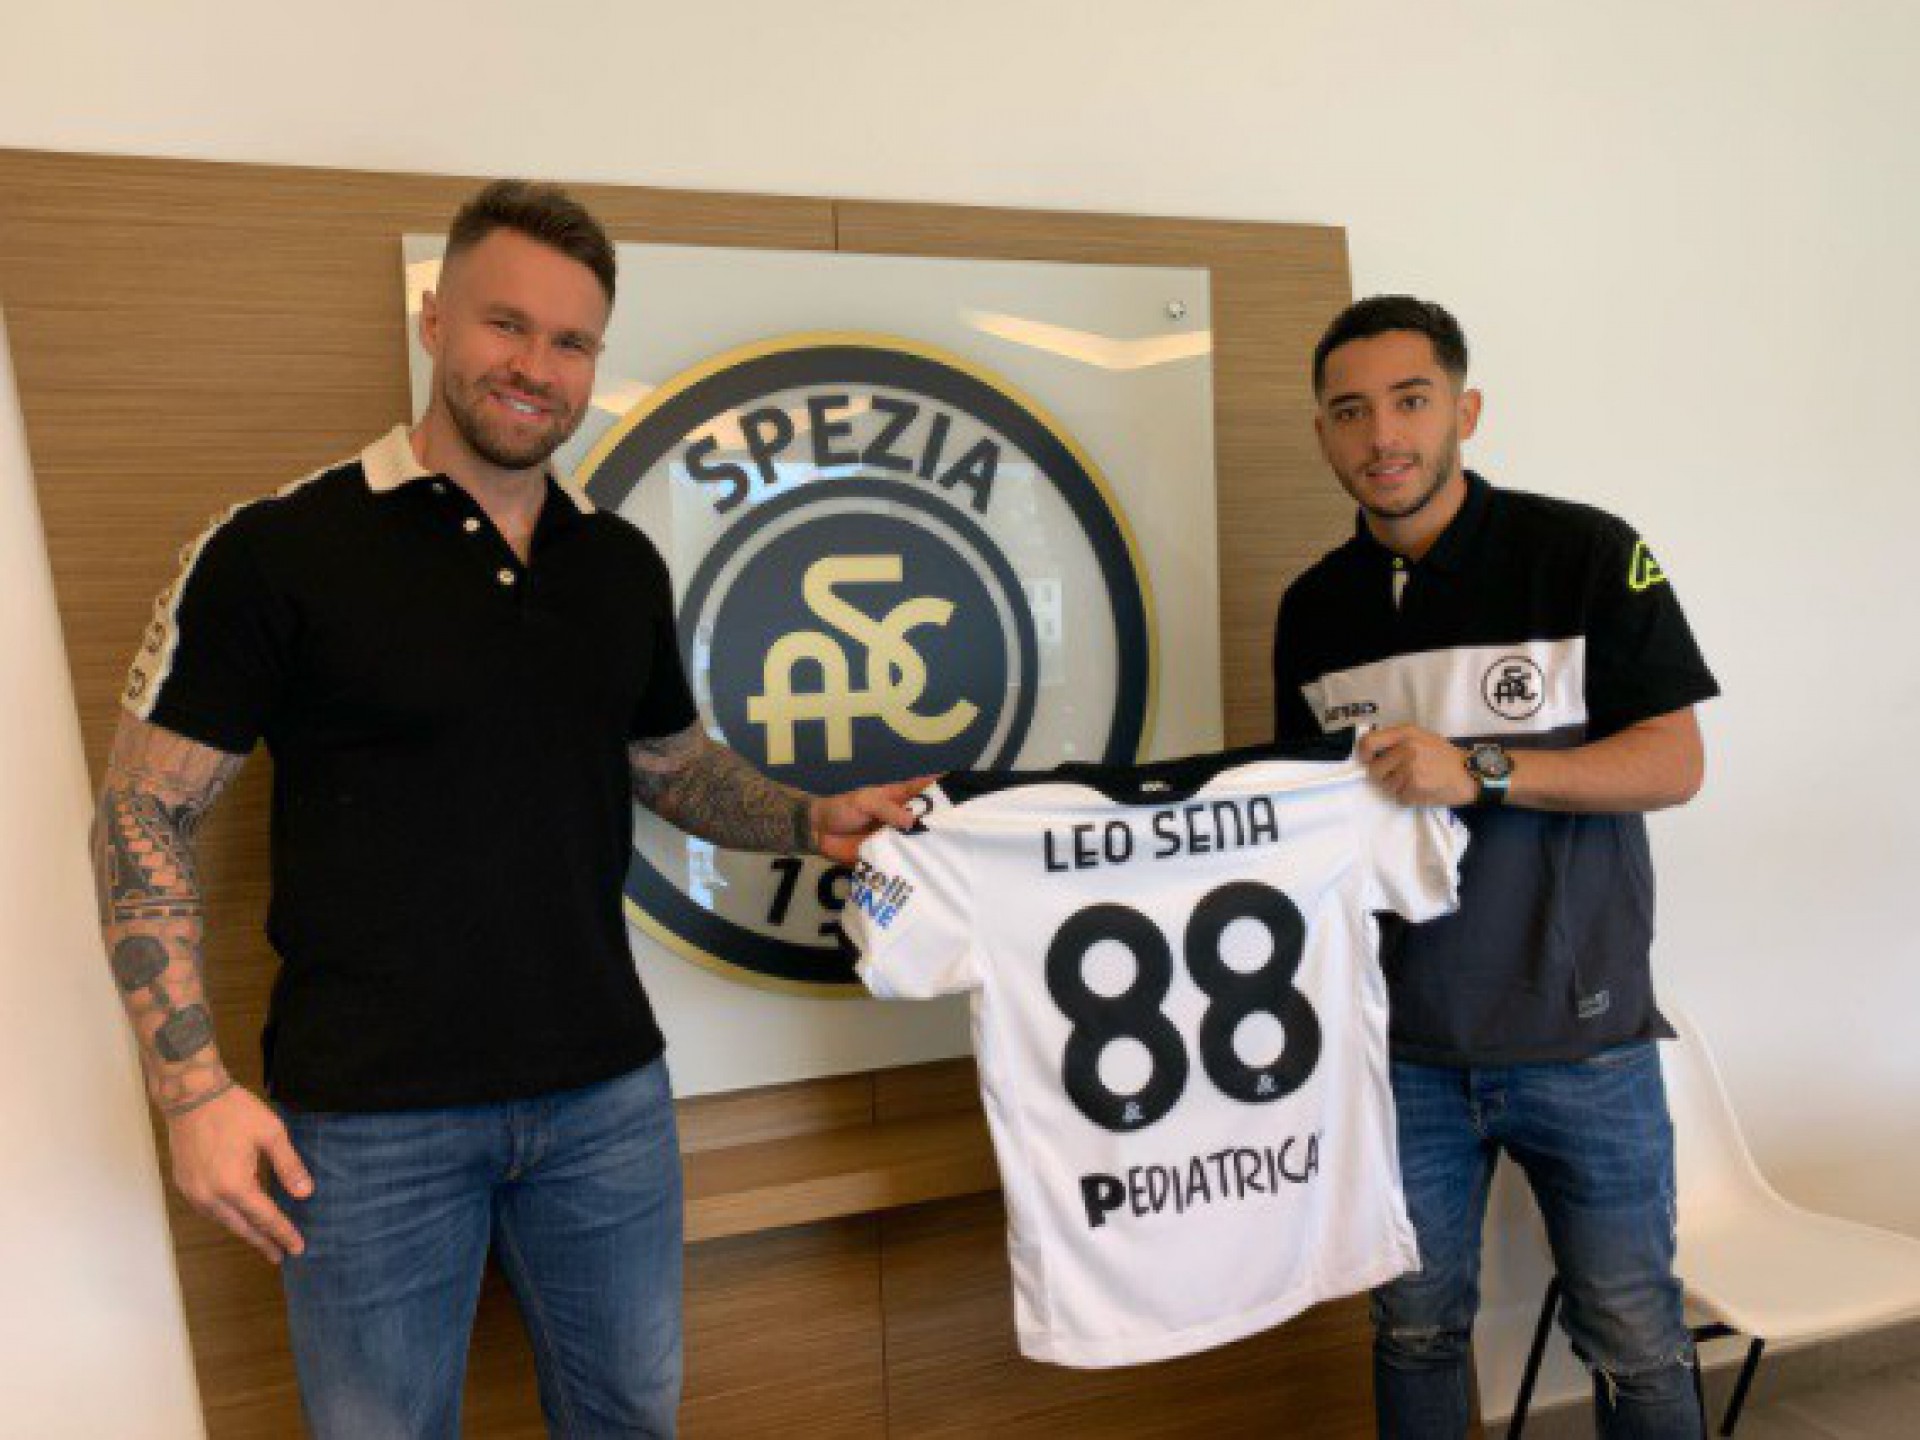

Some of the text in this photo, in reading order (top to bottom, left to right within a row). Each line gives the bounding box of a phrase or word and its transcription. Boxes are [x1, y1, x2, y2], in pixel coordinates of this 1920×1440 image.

[683, 394, 998, 514] SPEZIA
[1044, 796, 1279, 872] LEO SENA
[1045, 879, 1322, 1132] 88
[1079, 1132, 1320, 1230] PEDIATRICA
